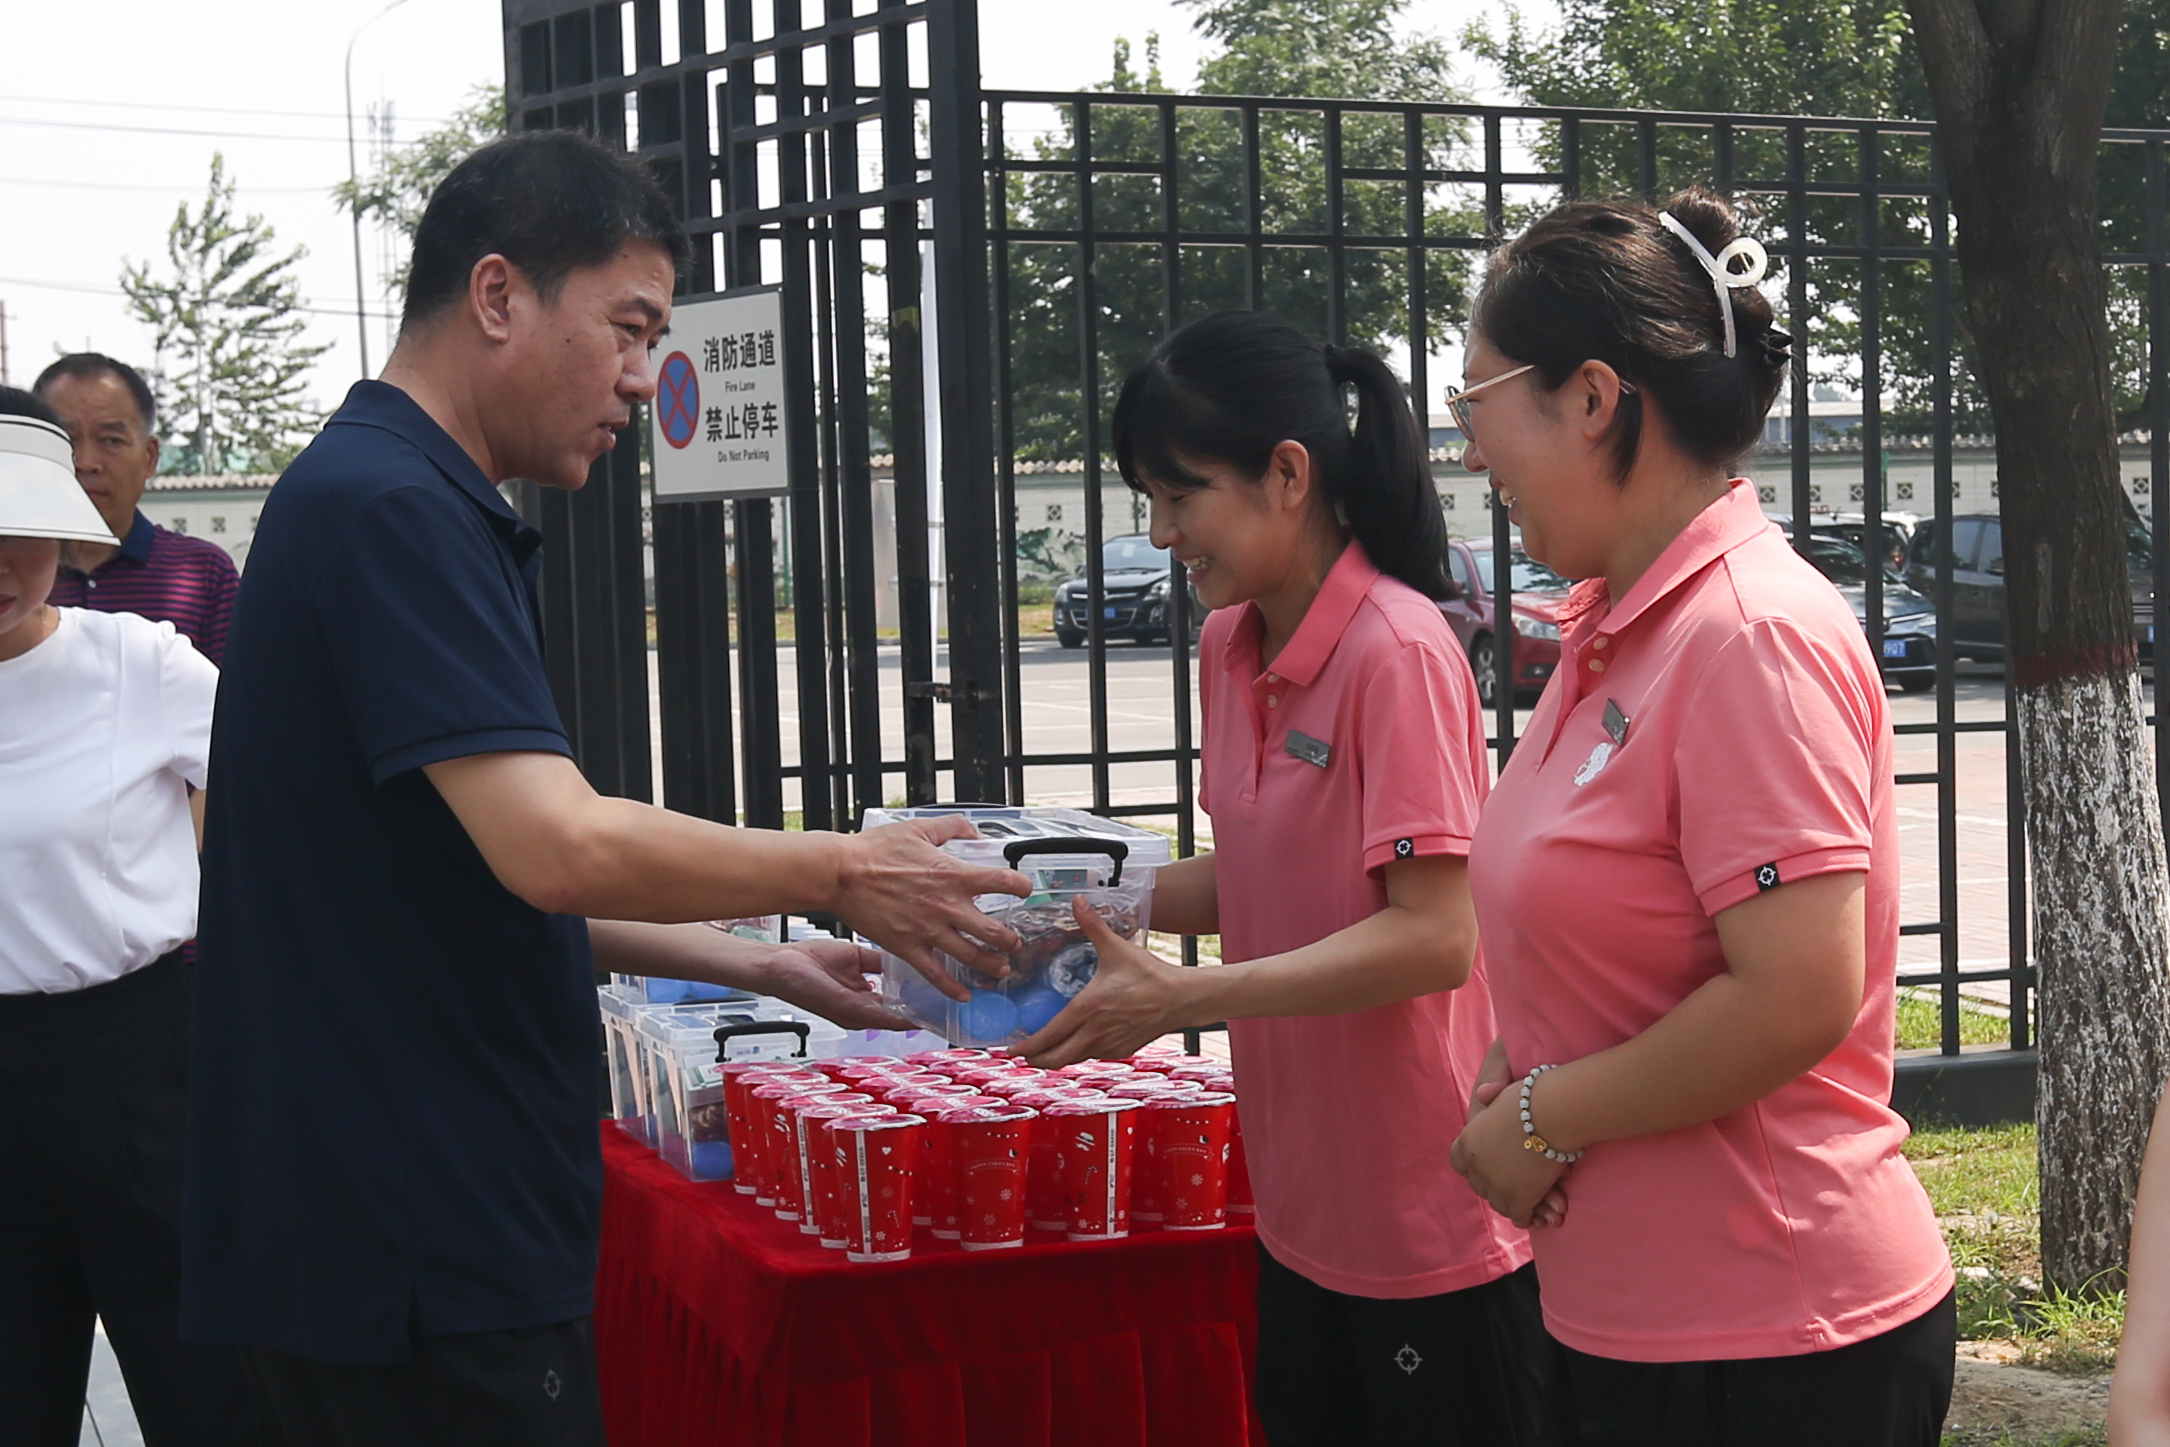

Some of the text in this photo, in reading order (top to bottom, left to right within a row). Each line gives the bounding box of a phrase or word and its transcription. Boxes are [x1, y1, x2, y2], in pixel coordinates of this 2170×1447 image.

[703, 330, 776, 373] 消防通道
[725, 380, 756, 393] Fire Lane
[706, 401, 779, 442] 禁止停车
[718, 448, 769, 463] Do Not Parking
